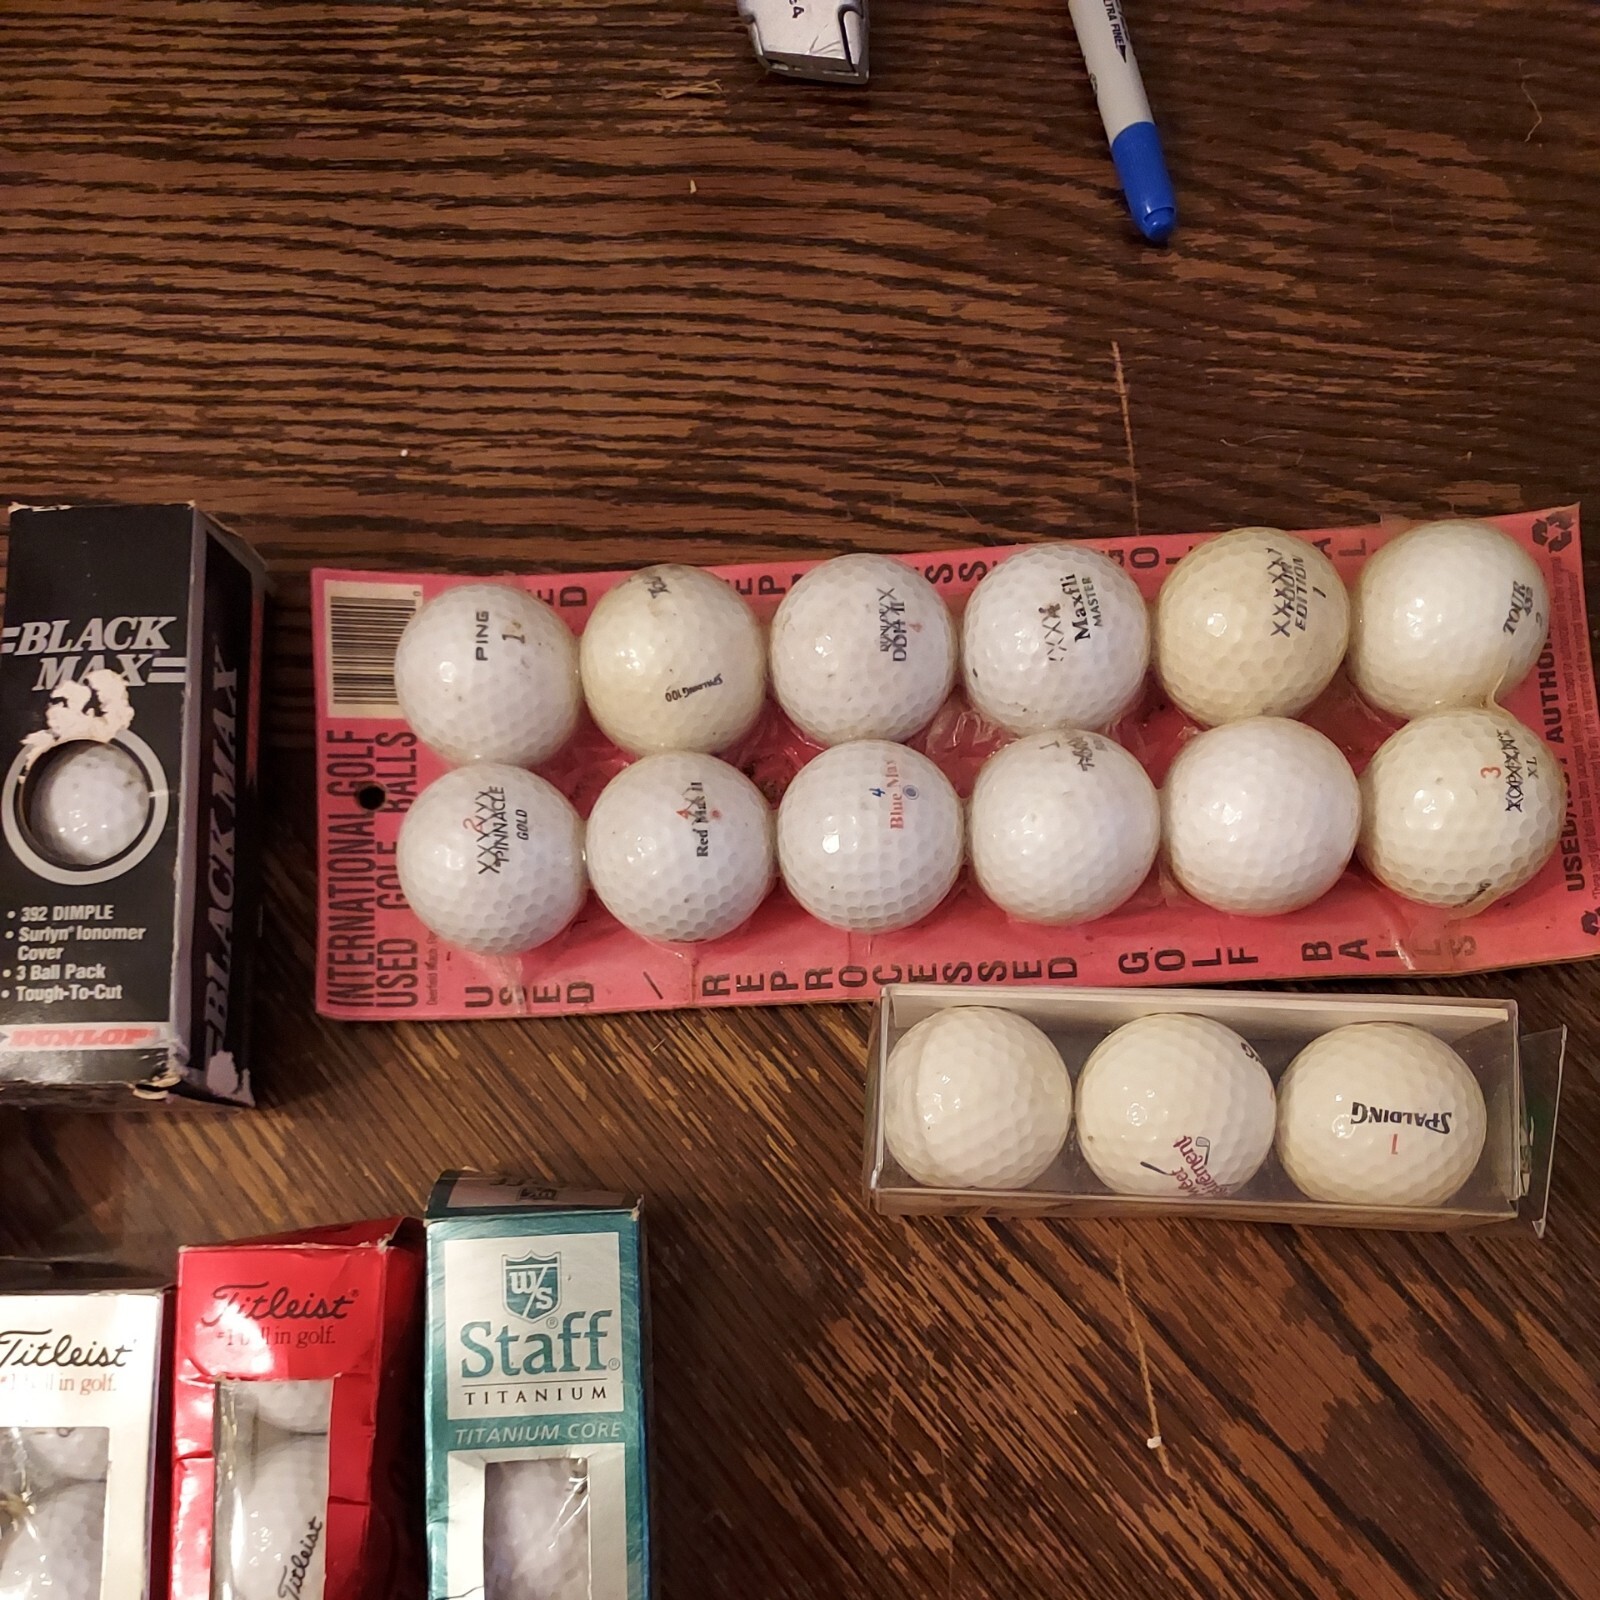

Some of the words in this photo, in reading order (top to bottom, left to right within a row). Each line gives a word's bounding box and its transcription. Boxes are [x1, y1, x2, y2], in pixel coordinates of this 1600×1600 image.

[1060, 573, 1090, 643] Maxfli
[1081, 577, 1103, 628] MASTER
[1292, 555, 1307, 632] EDITION
[1502, 580, 1525, 636] TOUR
[14, 616, 177, 656] BLACK
[475, 610, 489, 662] PING
[212, 638, 238, 817] MAX
[327, 730, 376, 798] GOLF
[375, 731, 418, 813] BALLS
[1480, 766, 1501, 779] 3
[1526, 756, 1539, 780] XL
[488, 786, 510, 867] PINNACLE
[515, 808, 530, 840] GOLD
[889, 793, 904, 830] Blue
[692, 829, 708, 857] Red
[21, 906, 48, 922] 392
[53, 905, 114, 921] DIMPLE
[206, 808, 236, 1033] BLACK
[327, 811, 376, 1007] INTERNATIONAL
[76, 925, 146, 940] Ionomer
[17, 945, 64, 961] Cover
[15, 965, 26, 981] 3
[30, 964, 60, 980] Ball
[65, 963, 106, 979] Pack
[376, 938, 419, 1007] USED
[702, 957, 1078, 996] REPROCESSED
[1118, 947, 1260, 975] GOLF
[15, 984, 123, 1003] Tough-To-Cut
[9, 1028, 156, 1046] DUNLOP
[1350, 1102, 1452, 1135] SPALDING
[1390, 1134, 1399, 1156] 1
[274, 1326, 291, 1345] in
[295, 1325, 337, 1349] golf.
[460, 1309, 613, 1378] Staff
[59, 1372, 75, 1391] in
[464, 1386, 608, 1406] TITANIUM
[456, 1423, 560, 1446] TITANIUM
[568, 1421, 622, 1439] CORE
